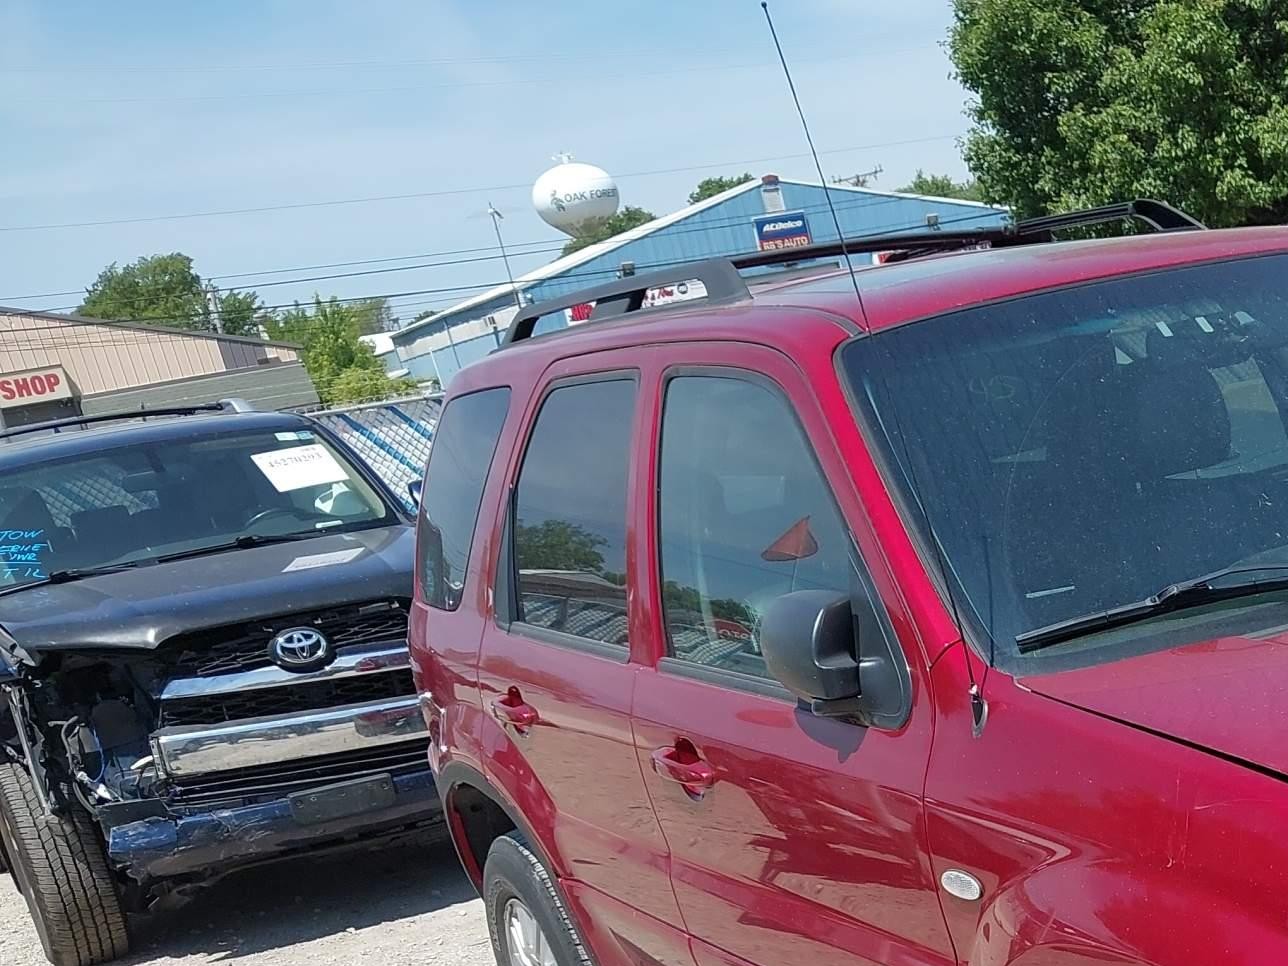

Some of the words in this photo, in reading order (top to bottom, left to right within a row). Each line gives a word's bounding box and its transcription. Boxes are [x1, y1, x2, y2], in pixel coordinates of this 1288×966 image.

[564, 192, 588, 203] OAK
[783, 236, 808, 248] AUTO
[0, 373, 60, 400] SHOP
